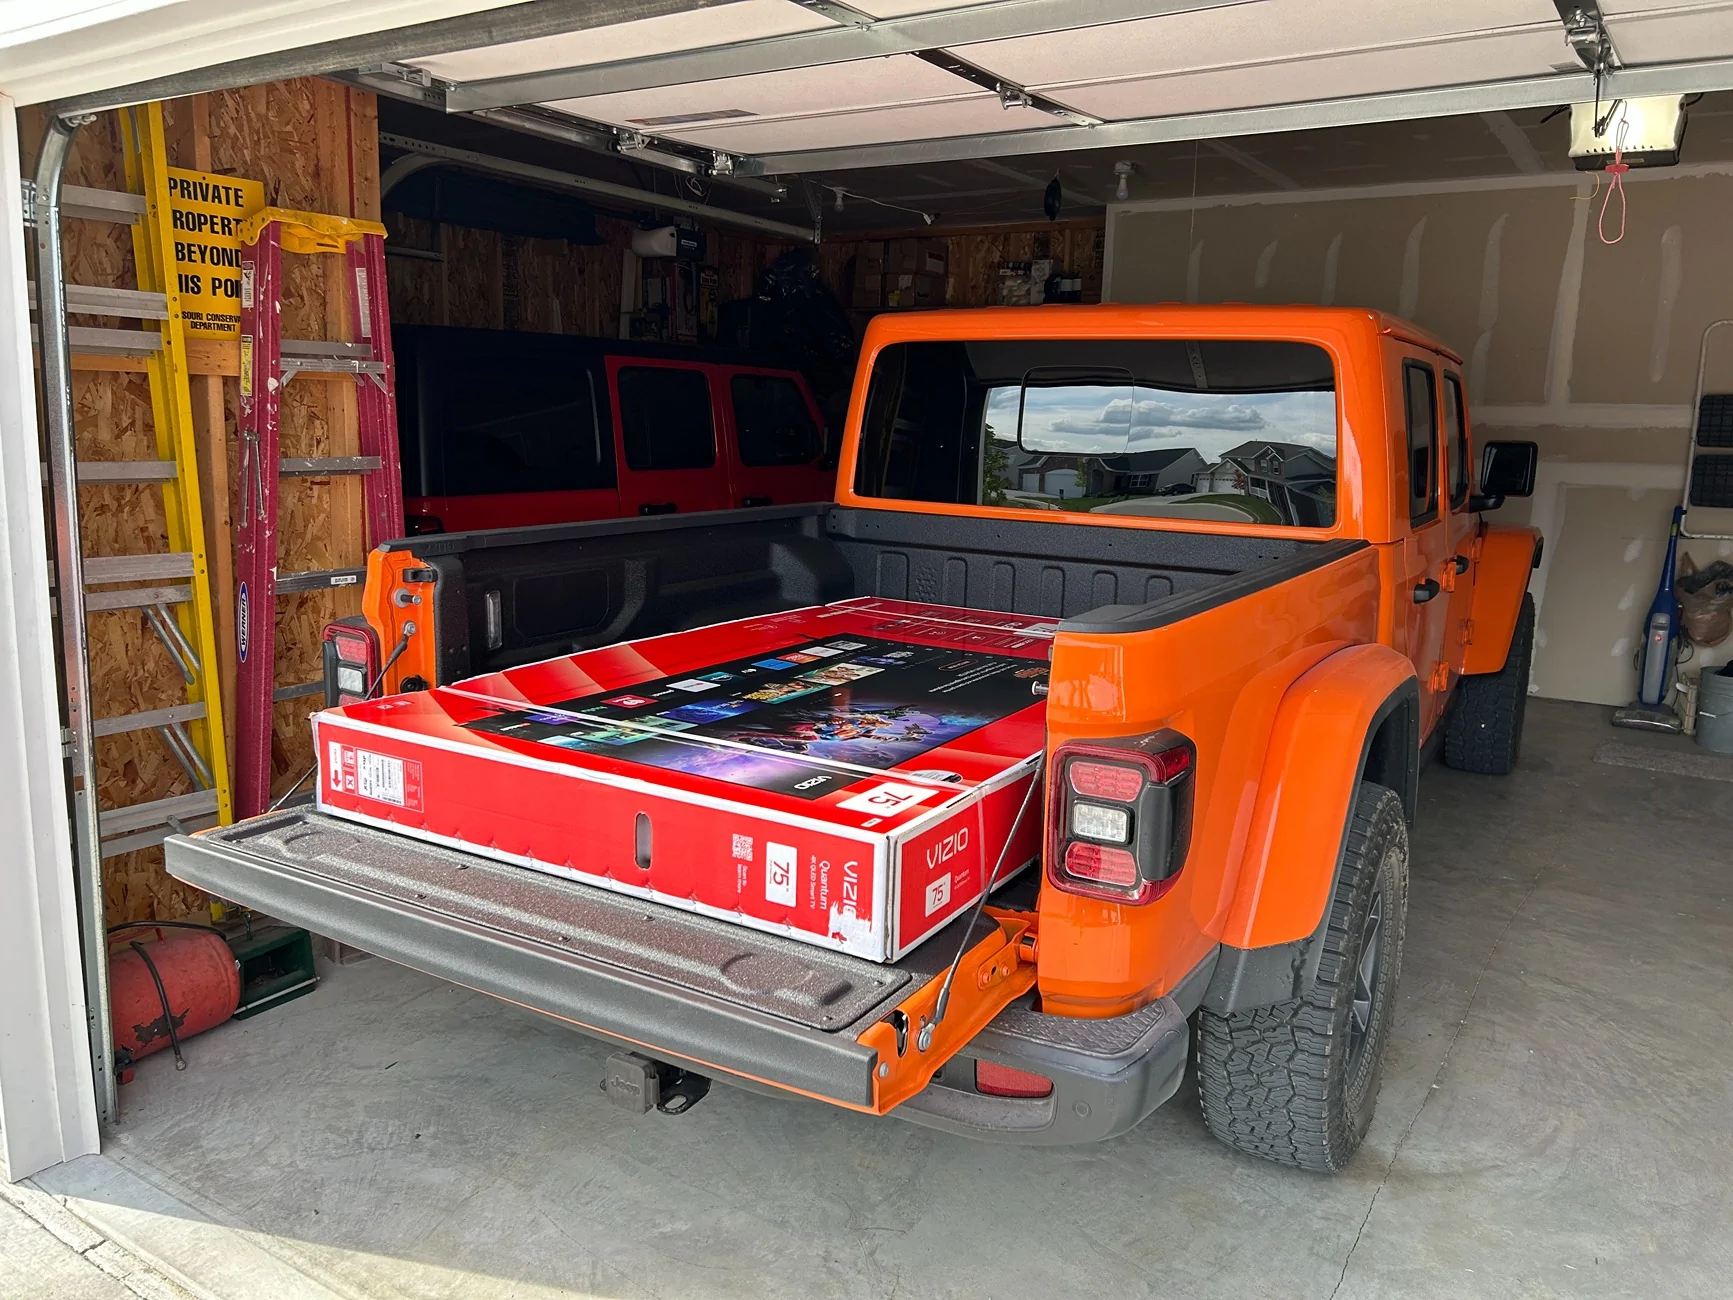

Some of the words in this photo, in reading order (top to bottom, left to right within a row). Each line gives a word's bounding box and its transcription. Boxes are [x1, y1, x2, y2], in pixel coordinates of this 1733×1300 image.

[168, 177, 244, 208] PRIVATE
[172, 209, 244, 237] ROPERT
[174, 241, 241, 268] BEYOND
[178, 273, 201, 295] IS
[211, 276, 241, 298] POI
[181, 310, 203, 320] SOURI
[206, 312, 241, 323] CONSERVA
[190, 320, 236, 332] DEPARTMENT
[794, 775, 833, 790] VIZIO
[867, 791, 914, 807] 75
[926, 827, 969, 870] VIZIO
[772, 860, 790, 886] 75
[819, 860, 830, 910] Quantum
[932, 883, 944, 906] 75
[610, 1074, 641, 1097] Jeep
